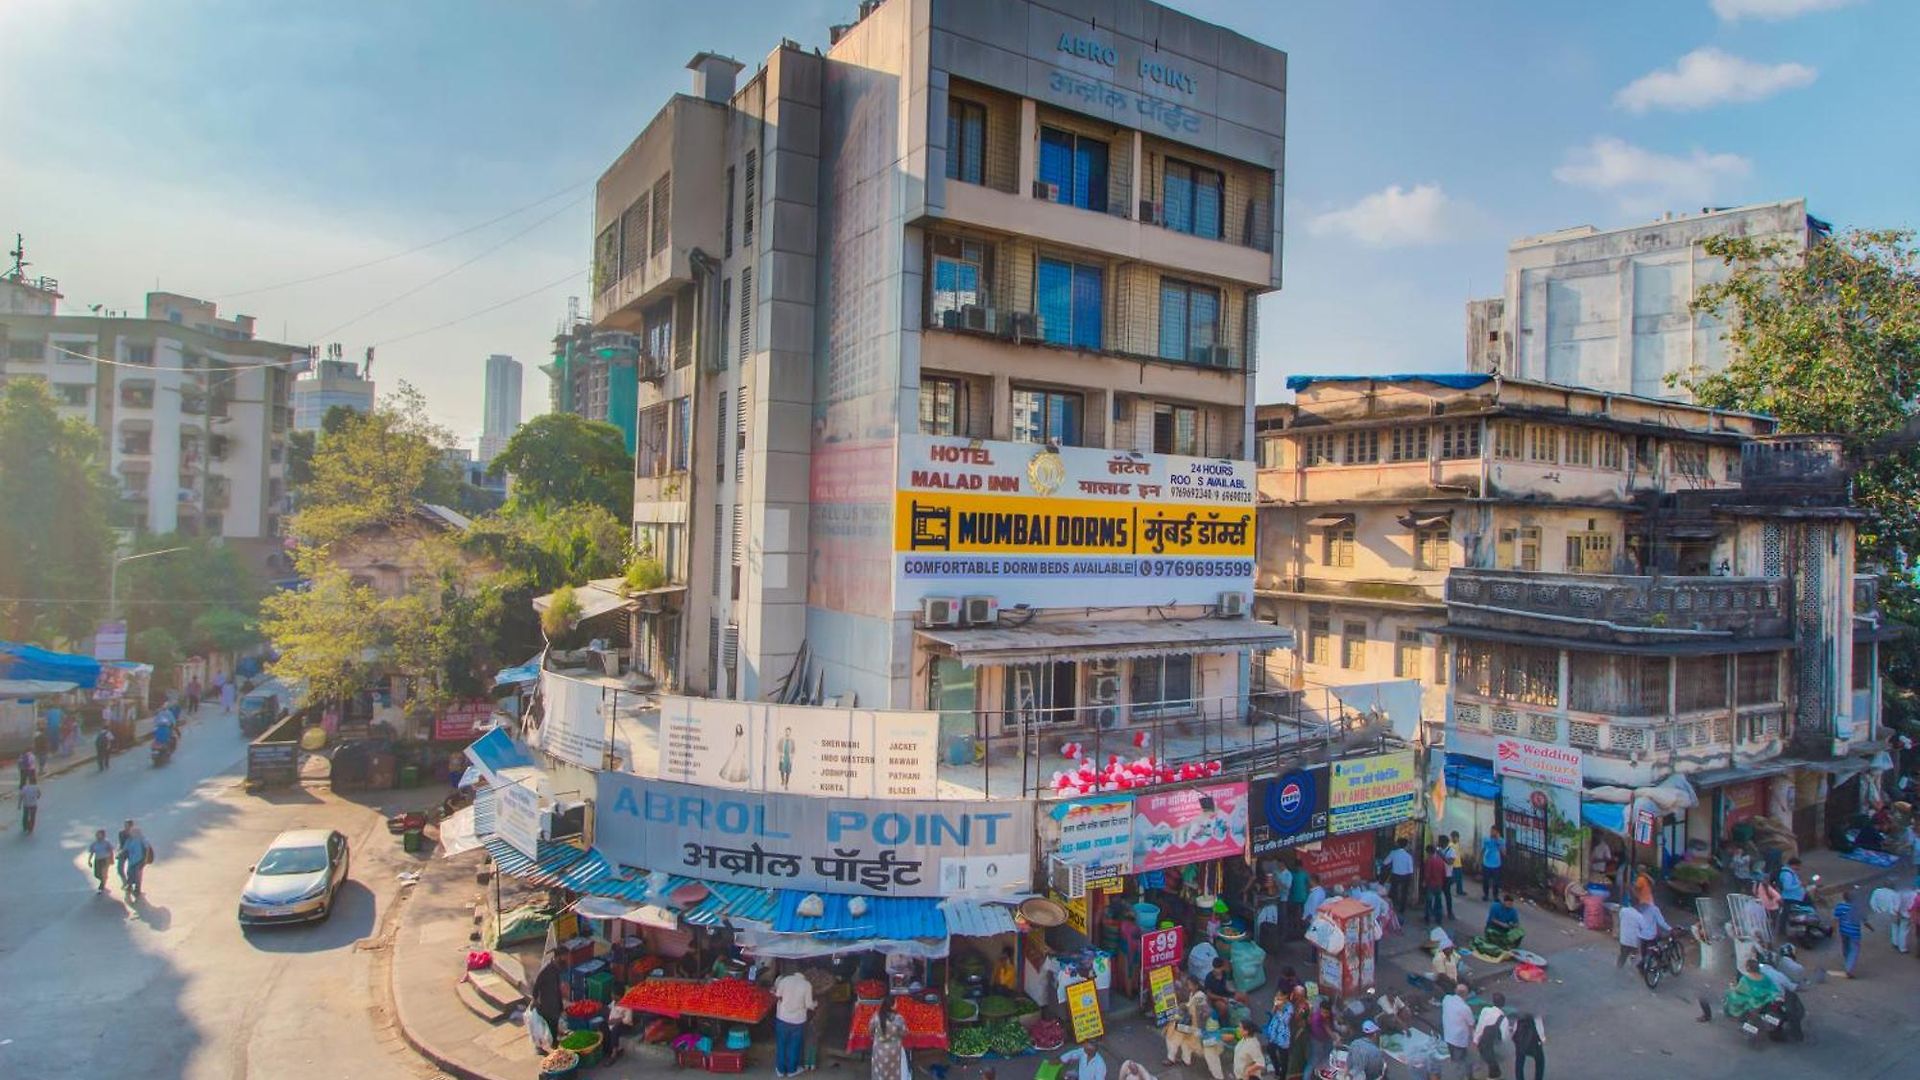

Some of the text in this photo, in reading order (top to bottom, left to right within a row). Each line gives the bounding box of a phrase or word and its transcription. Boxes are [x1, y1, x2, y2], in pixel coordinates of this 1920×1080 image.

[1137, 54, 1199, 95] POINT
[931, 444, 995, 465] HOTEL
[1107, 453, 1151, 475] हॉटेल
[1191, 463, 1234, 476] 24 HOURS
[911, 470, 983, 490] MALAD
[988, 475, 1020, 492] INN
[1137, 484, 1162, 499] इन
[958, 512, 1128, 547] MUMBAI DORMS
[1143, 511, 1198, 554] मुंबई
[904, 561, 1000, 574] COMFORTABLE
[1003, 561, 1039, 575] DORM
[1040, 562, 1070, 575] BEDS
[1154, 560, 1252, 577] 9769695599
[821, 740, 860, 749] SHERWANI
[889, 743, 917, 751] JACKET
[821, 754, 875, 764] INDO WESTERN
[1523, 744, 1579, 765] Wedding
[820, 769, 858, 778] JODHPURI
[888, 772, 921, 780] PATHANI
[820, 783, 844, 791] KURTA
[888, 786, 916, 795] BLAZER
[612, 785, 791, 839] ABROL
[827, 811, 1013, 847] POINT
[683, 842, 802, 877] अब्रोल
